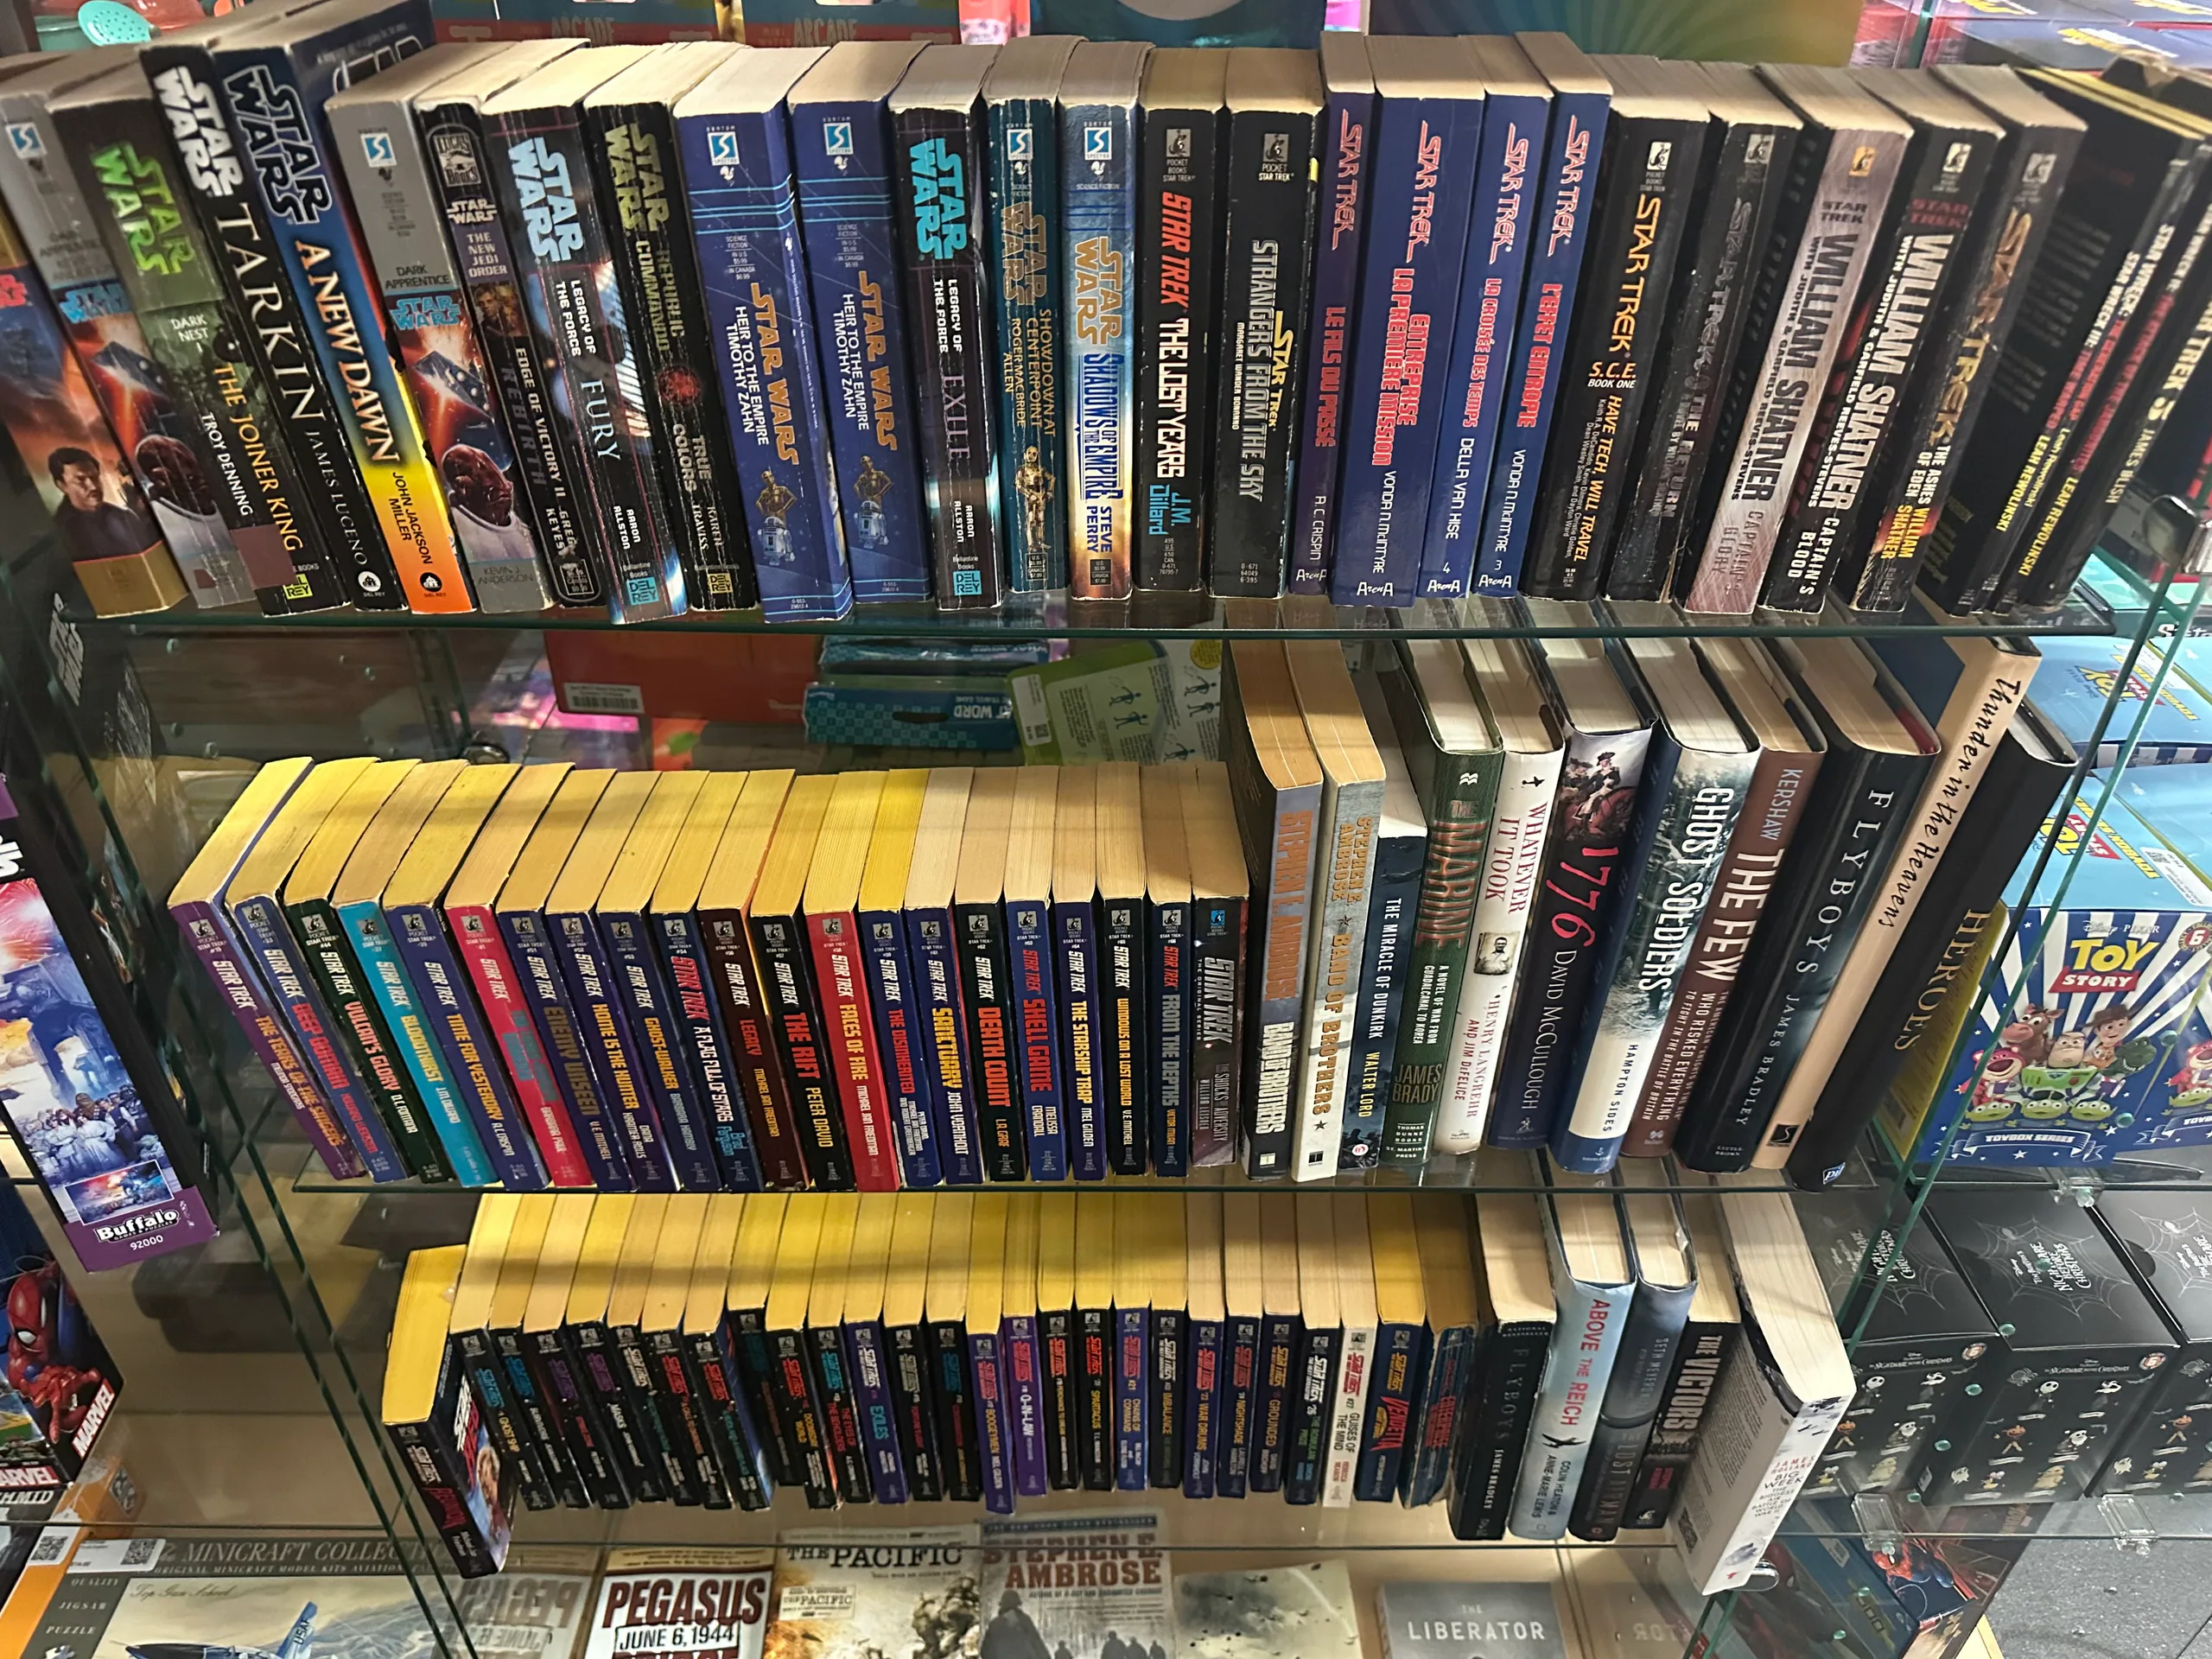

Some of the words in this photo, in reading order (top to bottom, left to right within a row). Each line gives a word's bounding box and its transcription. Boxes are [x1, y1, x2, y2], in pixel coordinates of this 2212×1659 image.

[154, 67, 223, 198] WARS
[175, 66, 244, 196] STAR
[223, 67, 301, 225] WARS
[251, 64, 333, 225] STAR
[94, 146, 170, 275] WARS
[125, 143, 194, 273] STAR
[507, 139, 559, 263] WARS
[533, 137, 584, 261] STAR
[1162, 192, 1192, 253] STAR
[1625, 193, 1662, 274] STAR
[296, 239, 330, 270] A
[1160, 255, 1190, 308] TREK
[1248, 240, 1278, 358] STRANGERS
[1872, 234, 1955, 374] WILLIAM
[171, 314, 207, 330] DARK
[178, 327, 210, 342] NEST
[308, 271, 365, 356] NEW
[734, 306, 750, 339] HEIR
[1609, 276, 1645, 353] TREK
[741, 342, 754, 360] TO
[1159, 317, 1189, 359] THE
[213, 363, 247, 407] THE
[214, 202, 327, 422] TARKIN
[305, 431, 340, 489] JAMES
[330, 491, 369, 566] LUCENO
[726, 324, 747, 389] TIMOTHY
[738, 391, 755, 433] ZAHN
[744, 365, 760, 392] THE
[750, 282, 783, 374] STAR
[767, 378, 799, 466] WARS
[1158, 363, 1187, 410] LOST
[1244, 364, 1270, 421] FROM
[1587, 378, 1614, 388] BOOK
[1616, 378, 1636, 389] ONE
[1589, 362, 1637, 378] S.C.E.
[339, 359, 401, 462] DAWN
[580, 380, 621, 461] FURY
[750, 396, 769, 446] EMPIRE
[942, 375, 970, 460] EXILE
[1607, 395, 1622, 435] HAVE
[200, 411, 226, 454] TROY
[216, 452, 253, 518] DENNING
[229, 412, 280, 493] JOINER
[672, 423, 696, 492] COLORS
[690, 434, 711, 480] TRUE
[1157, 412, 1186, 479] YEARS
[1242, 424, 1268, 461] THE
[1454, 437, 1475, 480] DELLA
[1595, 436, 1613, 475] TECH,
[1818, 384, 1896, 510] SHATNER
[2028, 435, 2050, 467] LEAH
[1239, 463, 1264, 501] SKY
[1589, 480, 1603, 514] WILL
[1996, 464, 2037, 532] REWOLINSKI
[266, 496, 304, 553] KING
[388, 497, 413, 542] MILLER
[391, 471, 411, 505] JOHN
[404, 504, 434, 564] JACKSON
[1086, 505, 1099, 553] PERRY
[1100, 506, 1112, 553] STEVE
[1149, 484, 1170, 536] Dillard
[1172, 493, 1192, 526] J.M.
[1446, 513, 1463, 540] HISE
[1573, 514, 1593, 562] TRAVEL
[1788, 532, 1815, 578] BLOOD
[1799, 518, 1840, 595] CAPTAIN'S
[1958, 677, 2021, 771] Thunder
[1759, 768, 1802, 841] KERSHAW
[1941, 778, 1971, 806] in
[1496, 816, 1520, 843] IT
[1676, 788, 1734, 868] GHOST
[1925, 801, 1958, 838] the
[1484, 846, 1512, 902] TOOK
[1509, 800, 1548, 914] WHATEVER
[1719, 849, 1784, 908] THE
[1546, 847, 1619, 948] 1776
[1796, 789, 1894, 973] FLYBOYS
[1878, 842, 1939, 928] Heavens
[1385, 898, 1402, 920] THE
[2124, 925, 2160, 934] PIXAR
[1376, 923, 1399, 973] MIRACLE
[1637, 882, 1703, 991] SOLDIERS
[1695, 919, 1758, 981] FEW
[2070, 939, 2159, 972] TOY
[1329, 933, 1352, 987] BAND
[1376, 975, 1392, 991] OF
[1547, 950, 1576, 1000] DAVID
[1895, 909, 1991, 1051] HEROES
[2061, 973, 2133, 988] STORY
[840, 1004, 861, 1037] FACES
[1023, 999, 1049, 1045] SHELL
[1071, 1001, 1087, 1021] THE
[1324, 992, 1344, 1014] OF
[1368, 992, 1389, 1039] DUNKIRK
[1769, 995, 1800, 1046] JAMES
[784, 1013, 811, 1042] THE
[846, 1039, 864, 1054] OF
[932, 1008, 963, 1089] SANCTUARY
[978, 1007, 1005, 1058] DEATH
[1073, 1023, 1092, 1071] STARSHIP
[645, 1017, 679, 1089] GHOST-WALKER
[791, 1046, 820, 1078] RIFT
[849, 1057, 868, 1081] FIRE
[1027, 1046, 1052, 1092] GAME
[1313, 1021, 1342, 1116] BROTHERS
[1362, 1051, 1380, 1090] WALTER
[1395, 1064, 1442, 1083] JAMES
[1614, 1045, 1638, 1096] HAMPTON
[805, 1088, 825, 1116] PETER
[983, 1058, 1010, 1107] COUNT
[1076, 1072, 1093, 1103] TRAP
[1357, 1092, 1375, 1117] LORD
[1392, 1083, 1439, 1103] BRADY
[1736, 1056, 1774, 1124] BRADLEY
[813, 1117, 834, 1147] DAVID
[1603, 1101, 1620, 1132] SIDES
[1986, 1133, 2035, 1143] TOYBOX
[2036, 1134, 2075, 1143] SERIES
[96, 1209, 179, 1242] Buffalo
[130, 1235, 163, 1250] 92000
[1580, 1300, 1611, 1351] ABOVE
[1699, 1336, 1722, 1357] THE
[1576, 1357, 1592, 1378] THE
[1560, 1382, 1587, 1426] REICH
[1666, 1357, 1717, 1431] VICTORS
[73, 1386, 115, 1459] MARVEL
[1333, 1430, 1345, 1451] MIND
[1337, 1414, 1348, 1429] THE
[1347, 1413, 1360, 1441] GUISES
[1345, 1443, 1356, 1452] OF
[1491, 1449, 1505, 1473] JAMES
[1483, 1474, 1499, 1510] BRADLEY
[1764, 1477, 1803, 1489] WEEK
[1775, 1471, 1799, 1480] BIG
[181, 1541, 308, 1562] MINICRAFT
[787, 1546, 829, 1560] THE
[830, 1544, 963, 1568] PACIFIC
[1006, 1560, 1162, 1588] AMBROSE
[71, 1578, 119, 1587] QUALITY
[603, 1577, 767, 1628] PEGASUS
[59, 1602, 107, 1611] JIGSAW
[46, 1626, 97, 1635] PUZZLE
[294, 1618, 309, 1646] USAF
[620, 1628, 667, 1648] JUNE
[672, 1626, 688, 1646] 6,
[690, 1624, 734, 1644] 1944
[1408, 1621, 1545, 1642] LIBERATOR
